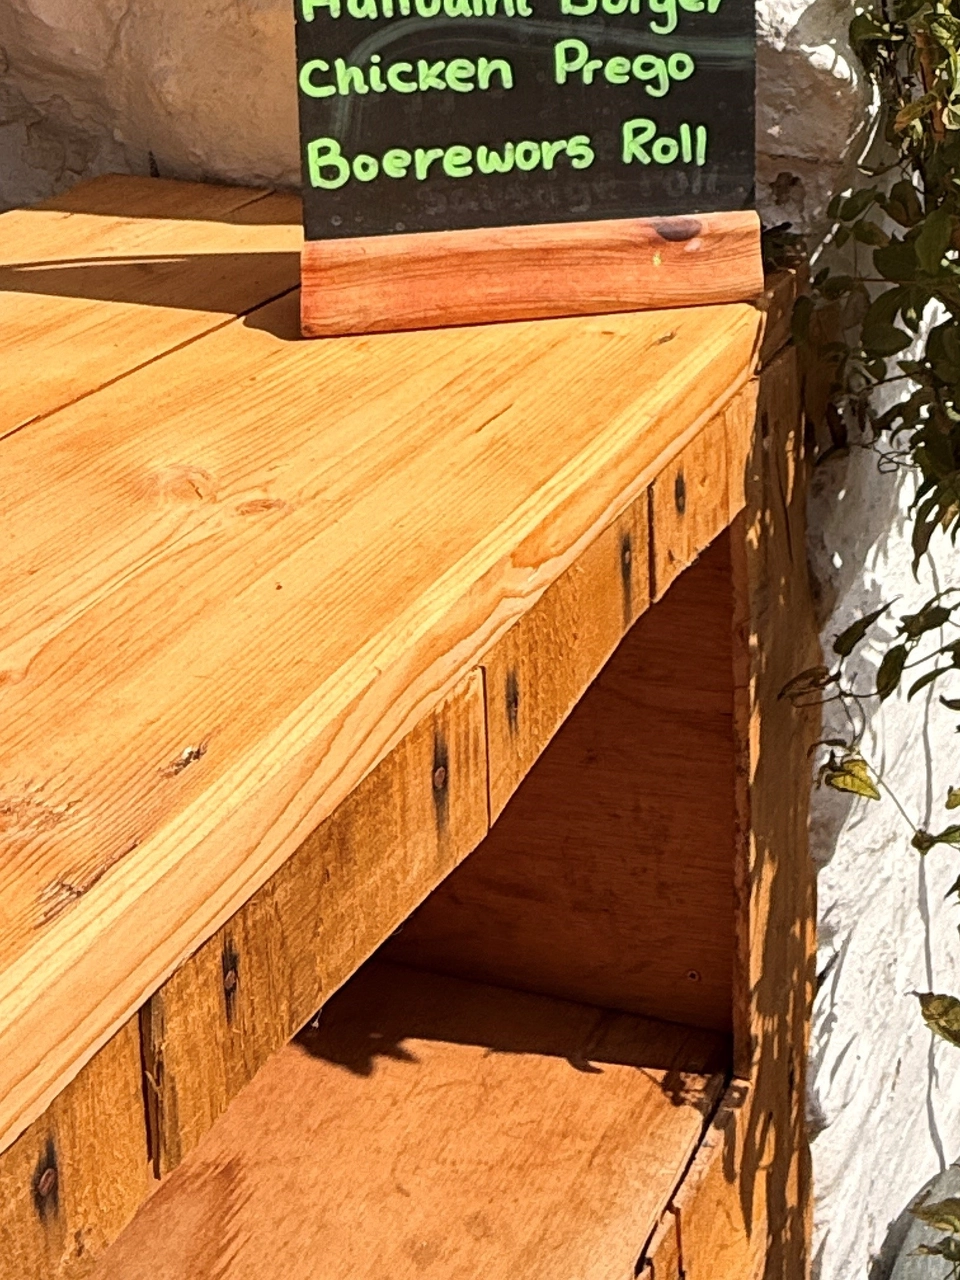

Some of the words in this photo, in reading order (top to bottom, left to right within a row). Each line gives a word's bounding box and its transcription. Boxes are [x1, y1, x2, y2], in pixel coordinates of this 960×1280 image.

[300, 54, 513, 98] Chicken
[554, 38, 694, 98] Prego
[307, 135, 594, 190] Boerewors
[622, 118, 708, 167] Roll
